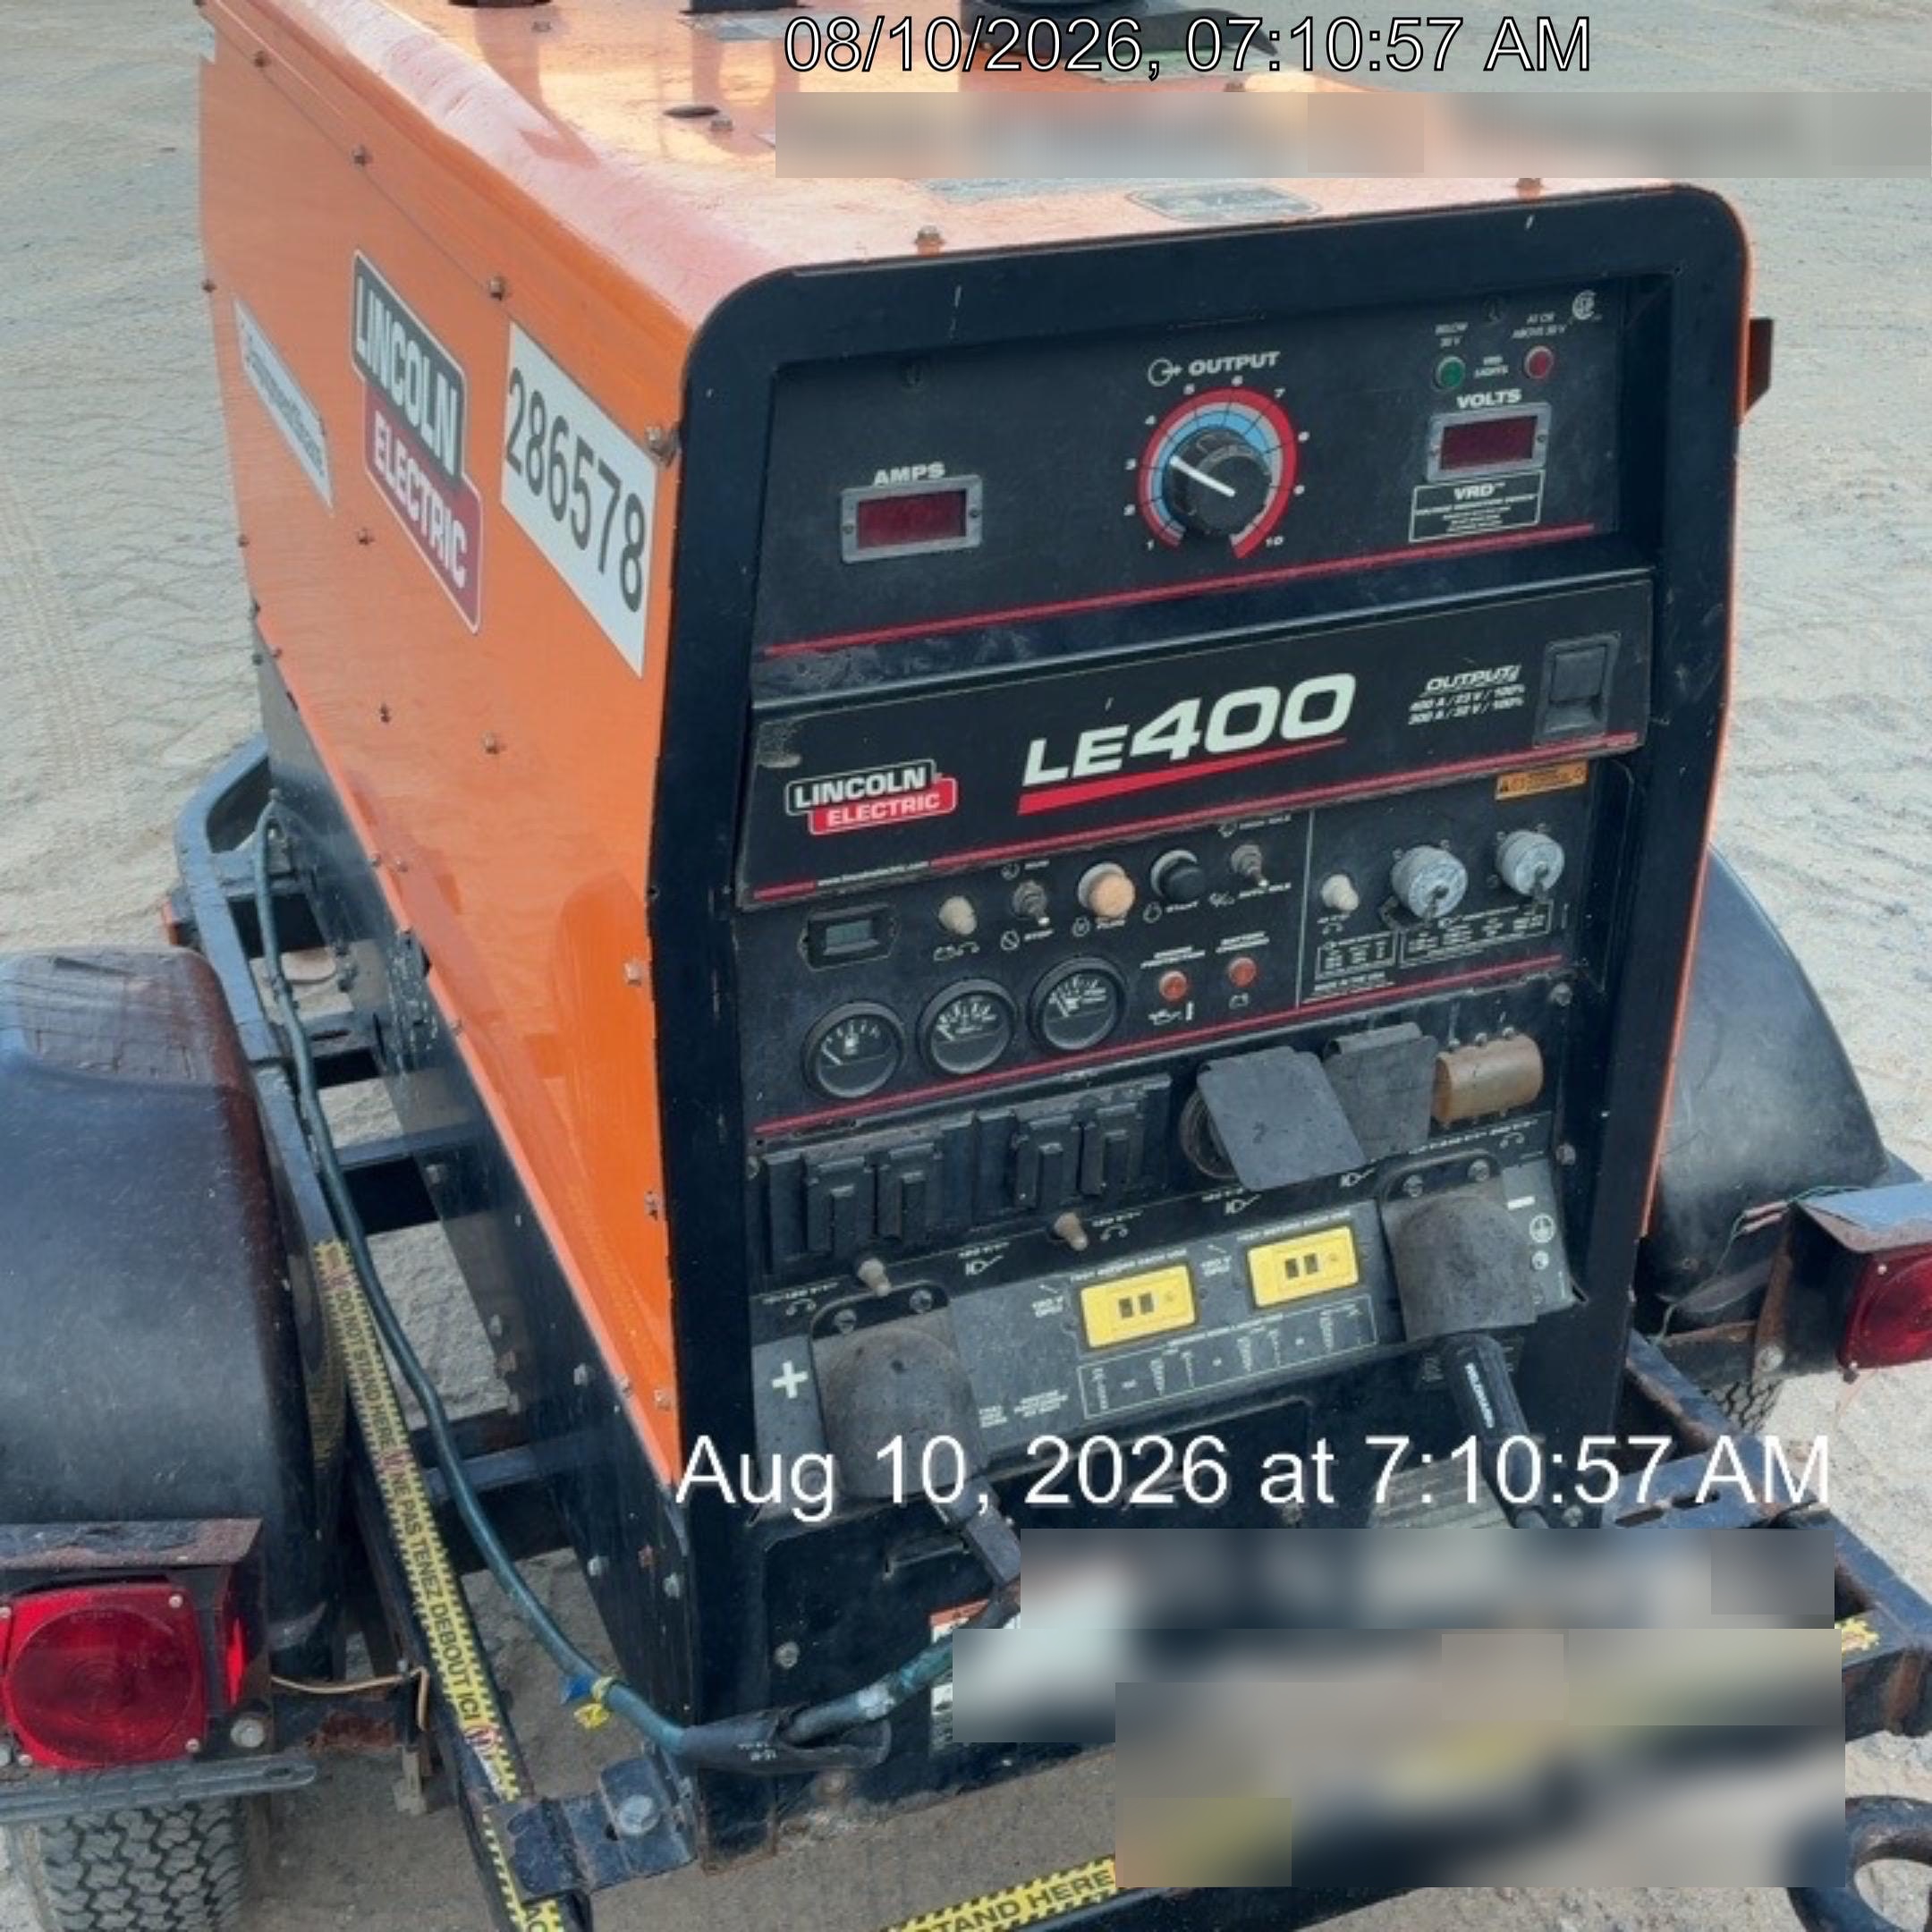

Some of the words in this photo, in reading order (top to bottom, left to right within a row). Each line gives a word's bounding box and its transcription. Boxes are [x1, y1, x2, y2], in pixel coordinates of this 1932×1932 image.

[356, 276, 459, 477] LINCOLN
[1189, 351, 1281, 377] OUTPUT
[1456, 388, 1522, 409] VOLTS
[375, 409, 466, 590] ELECTRIC
[505, 367, 646, 614] 286578
[873, 461, 946, 487] AMPS
[1021, 673, 1357, 788] LE400
[794, 767, 927, 809] LINCOLN
[826, 792, 940, 827] ELECTRIC
[335, 1291, 355, 1313] DO
[354, 1348, 382, 1402] STAND
[369, 1402, 397, 1450] HERE
[399, 1498, 423, 1535] PAS
[409, 1536, 445, 1601] TENEZ
[430, 1602, 473, 1688] DEBOUT
[457, 1689, 481, 1722] ICI
[919, 1898, 1021, 1932] TAND
[1025, 1868, 1114, 1909] HERE
